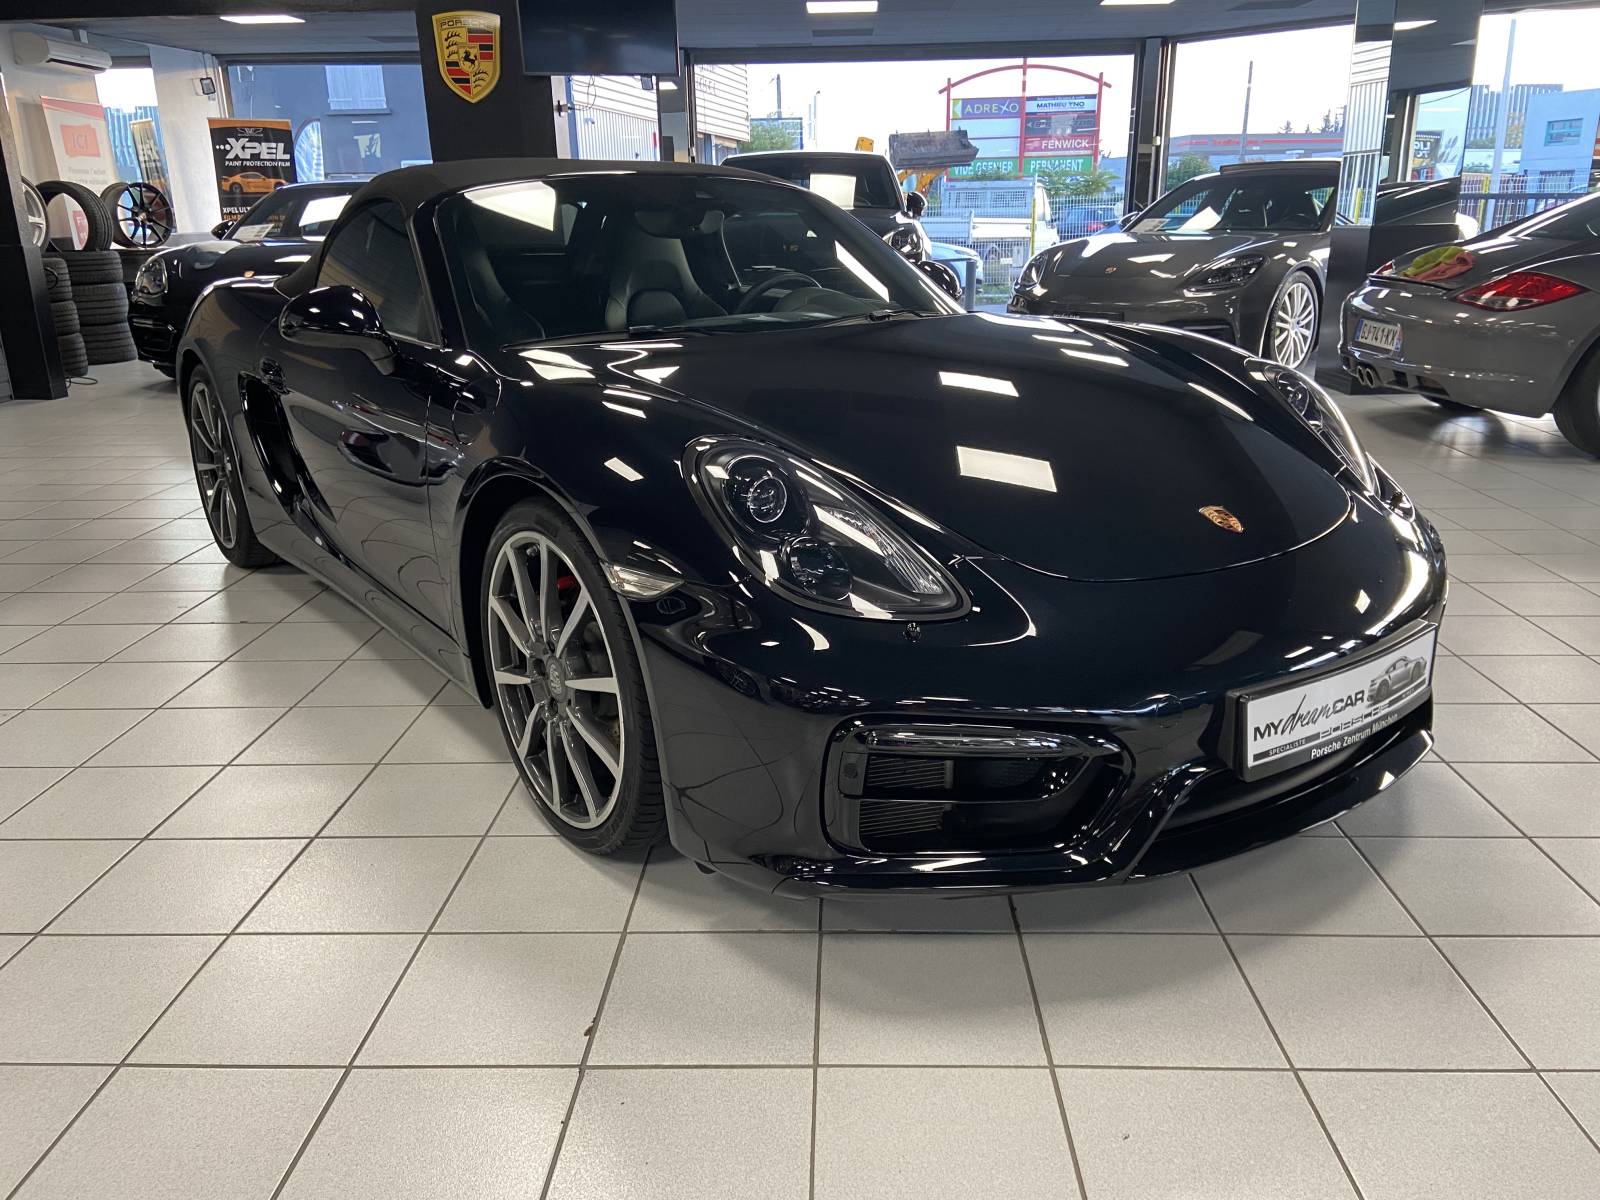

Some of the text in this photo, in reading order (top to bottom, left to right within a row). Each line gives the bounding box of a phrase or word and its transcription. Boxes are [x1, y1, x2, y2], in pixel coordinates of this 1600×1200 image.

[964, 100, 1019, 114] ADREXO
[225, 138, 290, 160] XPEL
[1041, 139, 1089, 149] FENWICK
[1268, 738, 1306, 756] SPECIALISTE
[1311, 742, 1342, 759] Porsche
[1342, 728, 1373, 747] Zentrum
